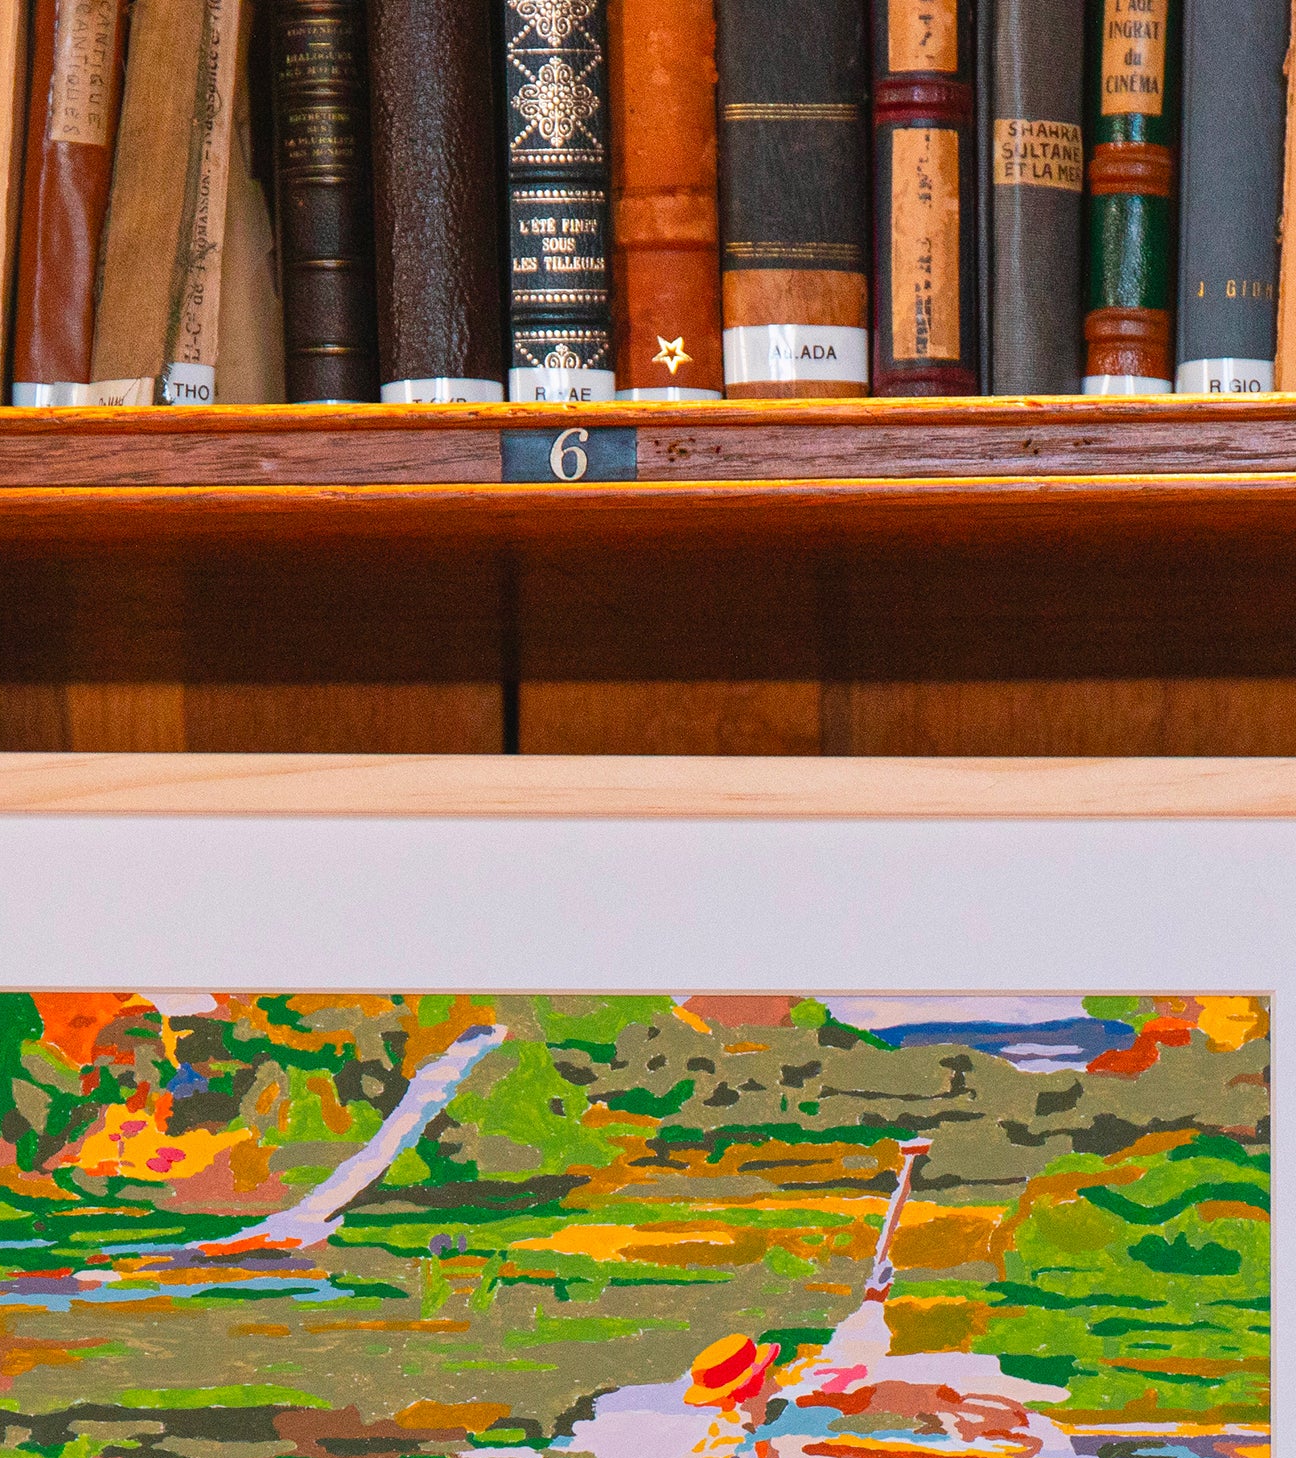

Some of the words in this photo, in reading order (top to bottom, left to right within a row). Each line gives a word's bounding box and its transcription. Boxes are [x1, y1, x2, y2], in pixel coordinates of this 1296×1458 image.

[1109, 21, 1160, 40] INGRAT
[1124, 48, 1142, 66] du
[1106, 71, 1159, 94] CINÉMA
[1001, 143, 1081, 161] SULTANE
[1005, 162, 1024, 177] ET
[1033, 163, 1053, 179] LA
[542, 238, 576, 251] SOUS
[513, 257, 538, 271] LES
[544, 256, 605, 272] TILLEULS
[173, 383, 210, 400] THO
[1210, 379, 1221, 393] R
[551, 427, 589, 481] 6
